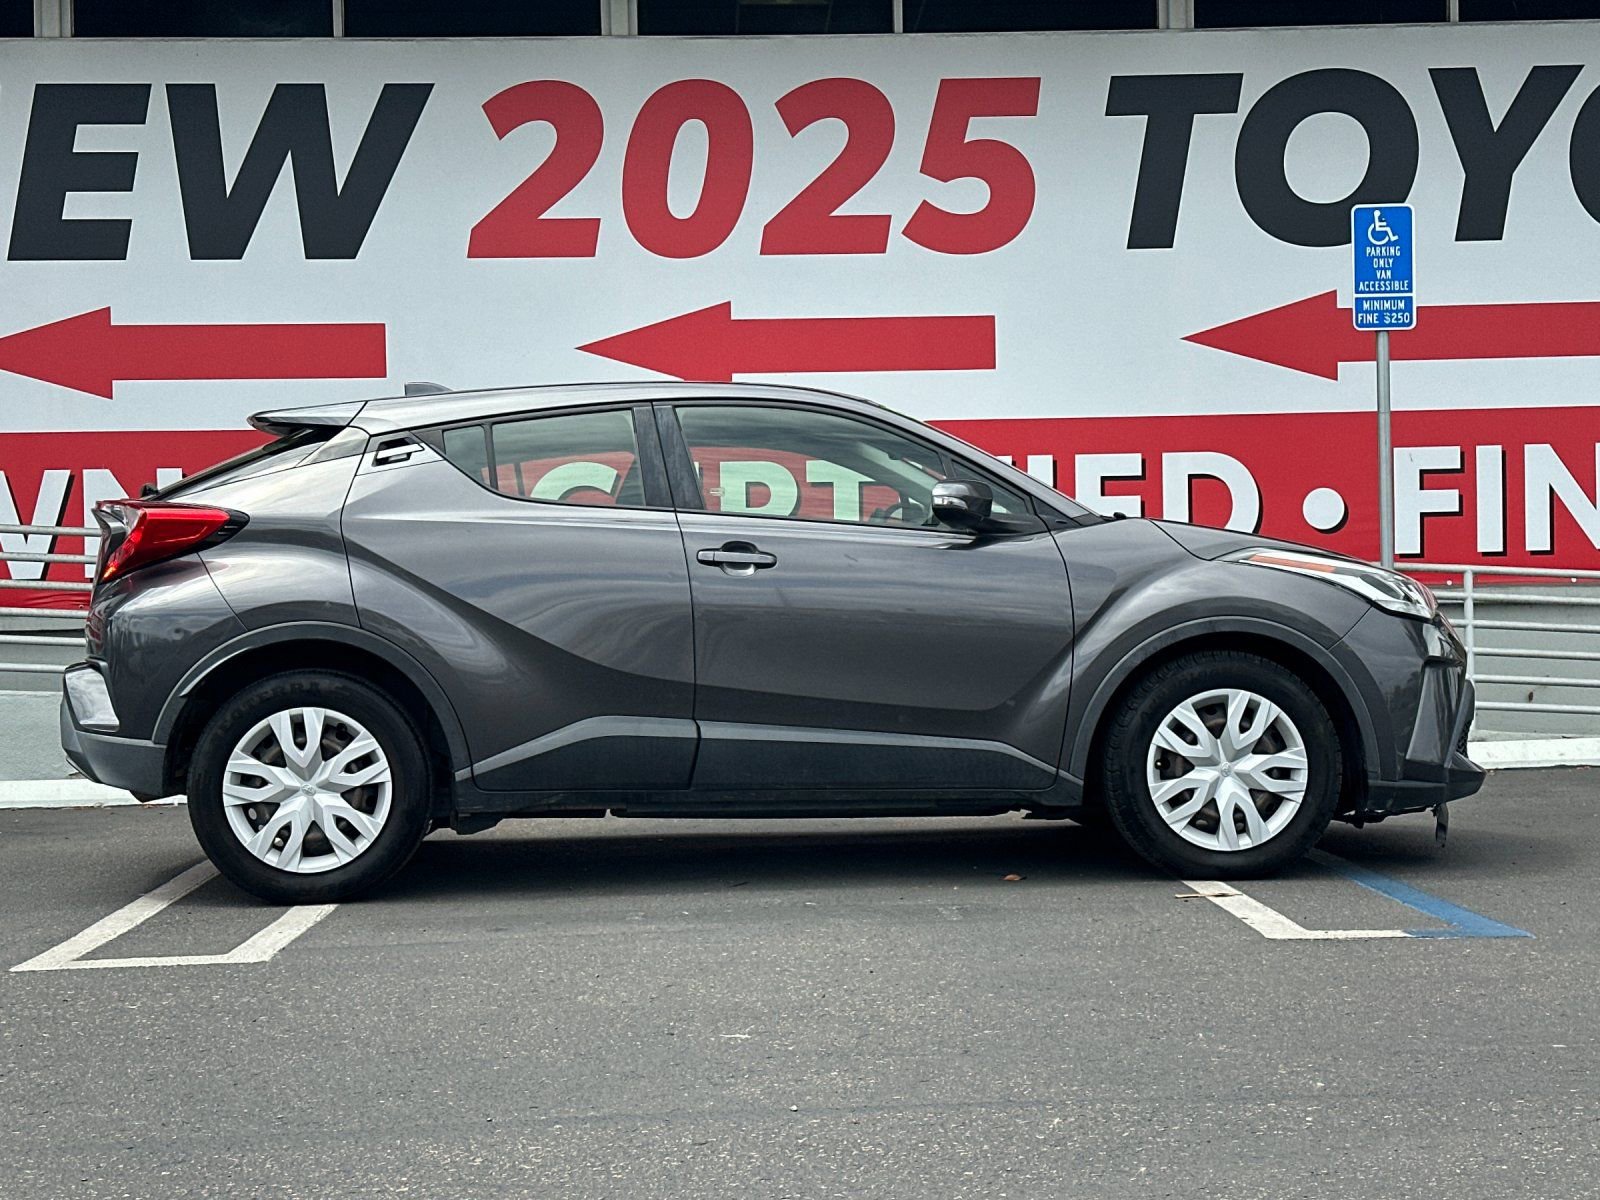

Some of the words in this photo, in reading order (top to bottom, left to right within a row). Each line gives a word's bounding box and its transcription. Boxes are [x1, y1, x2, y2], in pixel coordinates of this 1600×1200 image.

[7, 83, 435, 260] EW
[467, 77, 1041, 259] 2025
[1104, 64, 1600, 249] TOY
[1366, 246, 1401, 257] PARKING
[1373, 258, 1394, 268] ONLY
[1376, 269, 1392, 280] VAN
[1358, 280, 1409, 291] ACCESSIBLE
[1363, 299, 1405, 311] MINIMUM
[1358, 313, 1380, 324] FINE
[1383, 312, 1410, 324] $250
[1394, 443, 1600, 555] FIN
